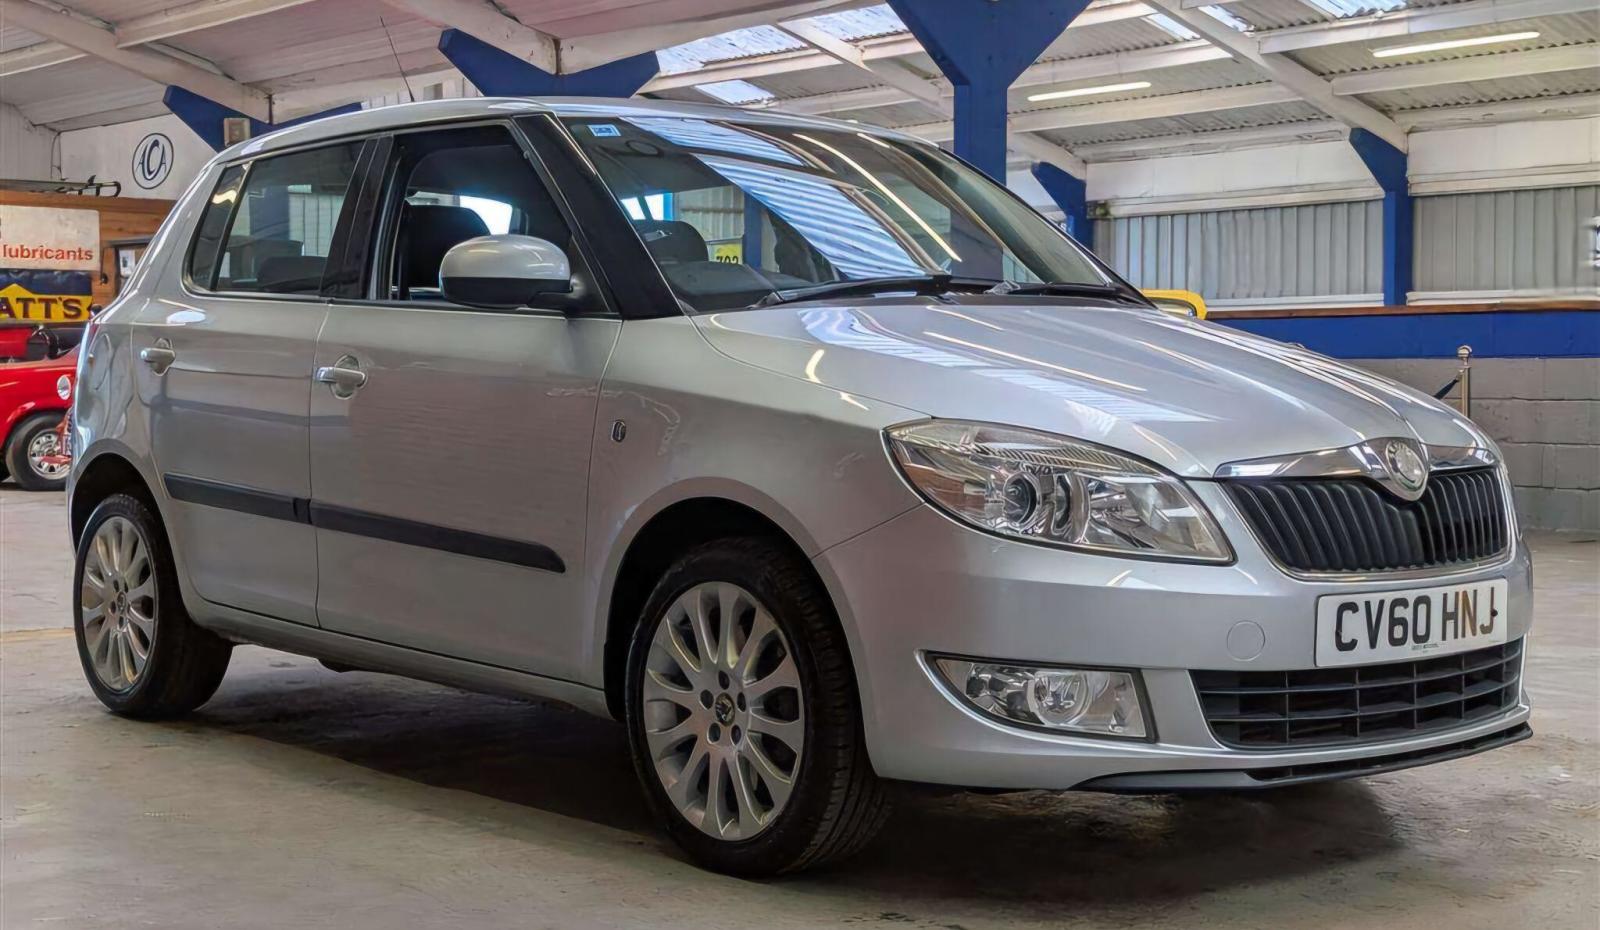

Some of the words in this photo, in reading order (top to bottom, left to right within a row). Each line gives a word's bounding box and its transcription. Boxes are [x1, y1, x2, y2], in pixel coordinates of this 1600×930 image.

[2, 244, 94, 261] lubricants
[1335, 595, 1431, 652] CV60
[1441, 587, 1498, 641] HNJ
